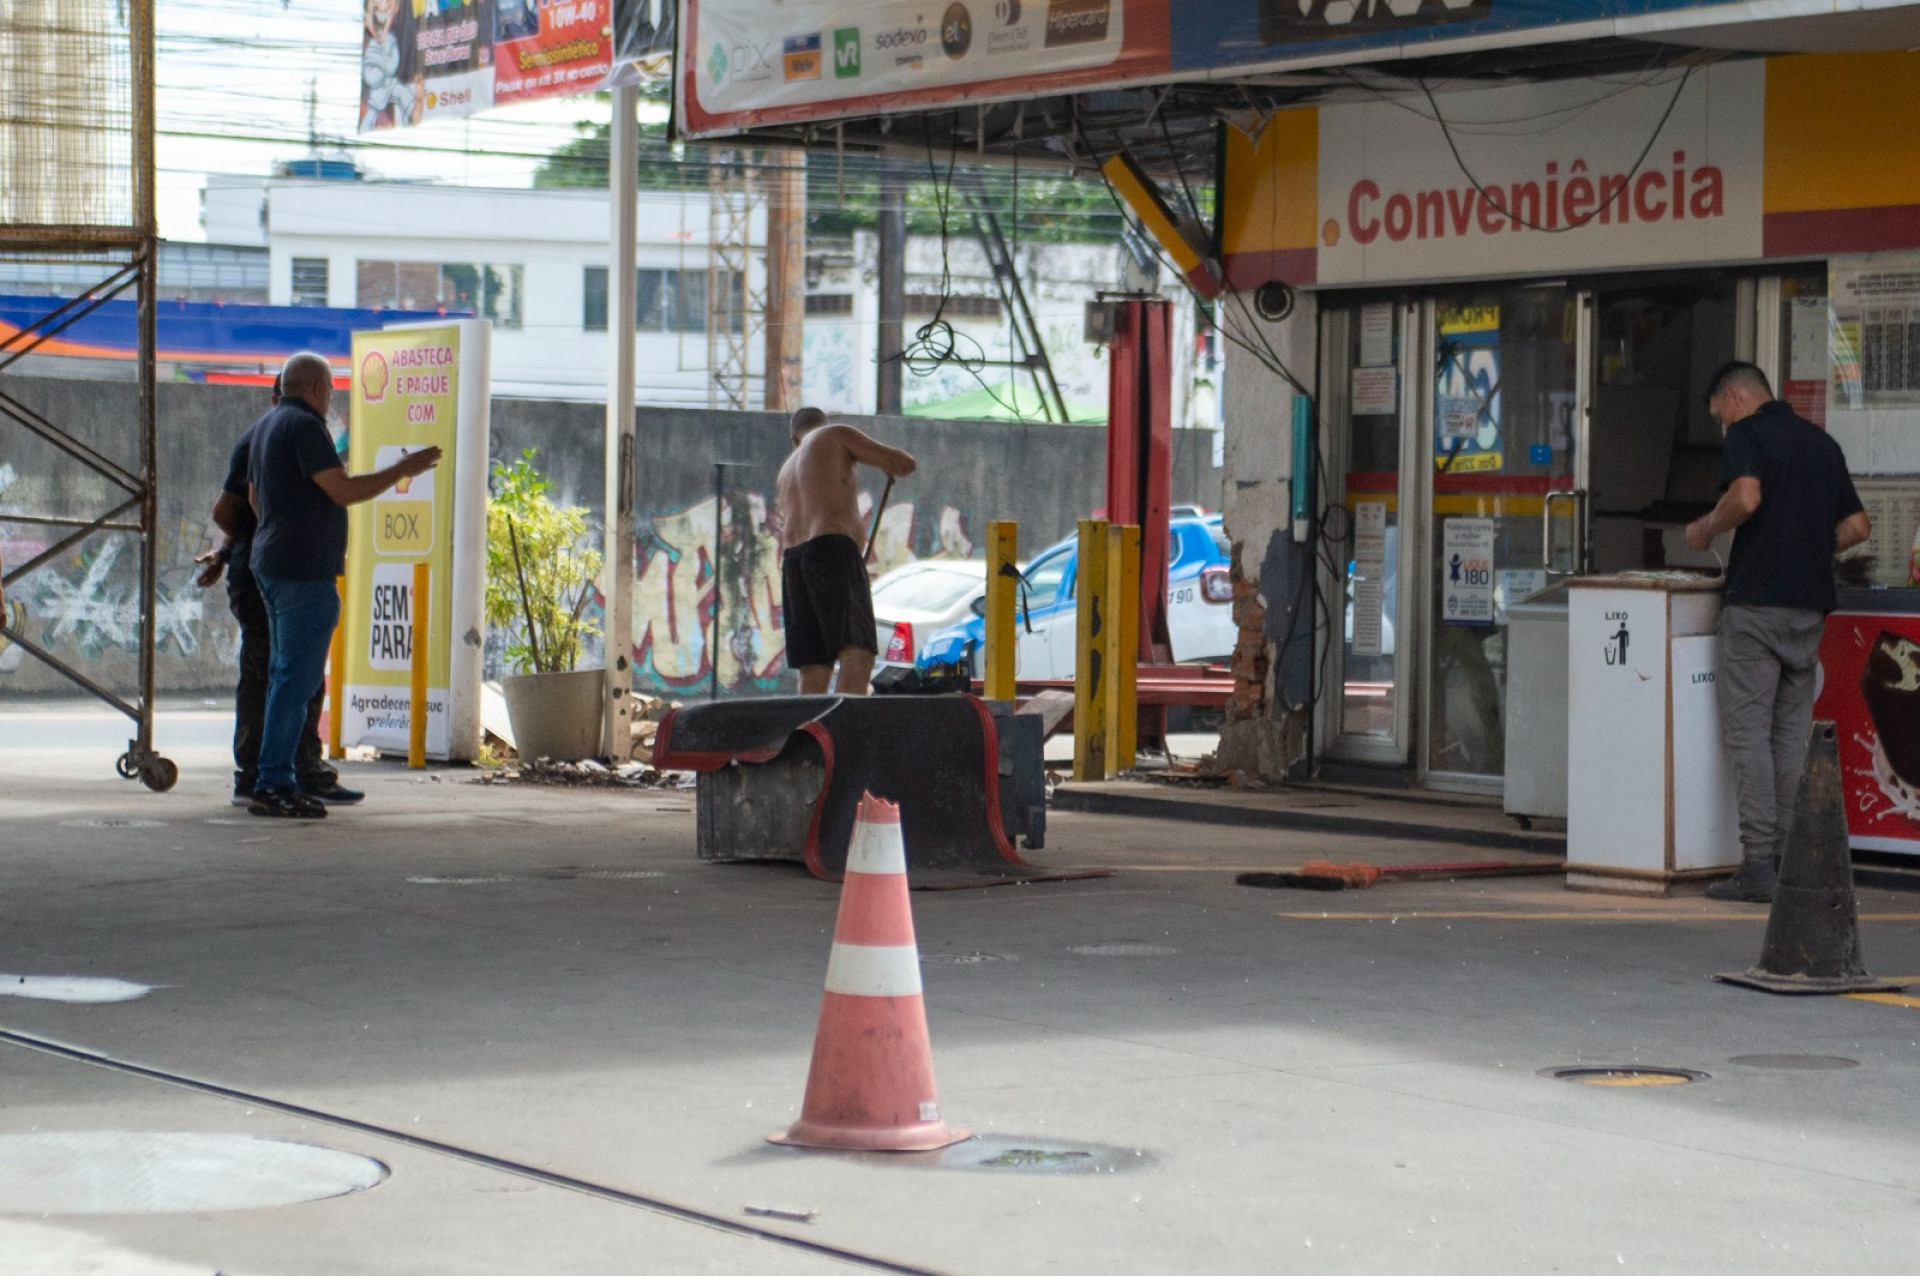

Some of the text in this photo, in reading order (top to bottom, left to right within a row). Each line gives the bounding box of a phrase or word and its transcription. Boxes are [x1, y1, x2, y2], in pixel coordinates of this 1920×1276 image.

[876, 28, 928, 50] sodexo
[439, 86, 472, 107] Shell
[1347, 150, 1724, 245] Conveniência
[391, 346, 453, 371] ABASTEÇA
[396, 374, 449, 395] E PAGUE
[407, 403, 435, 422] COM
[384, 512, 420, 541] BOX
[1464, 569, 1489, 585] 180
[373, 584, 409, 622] SEM
[1605, 612, 1628, 621] LIXO
[1692, 672, 1715, 684] LIXO
